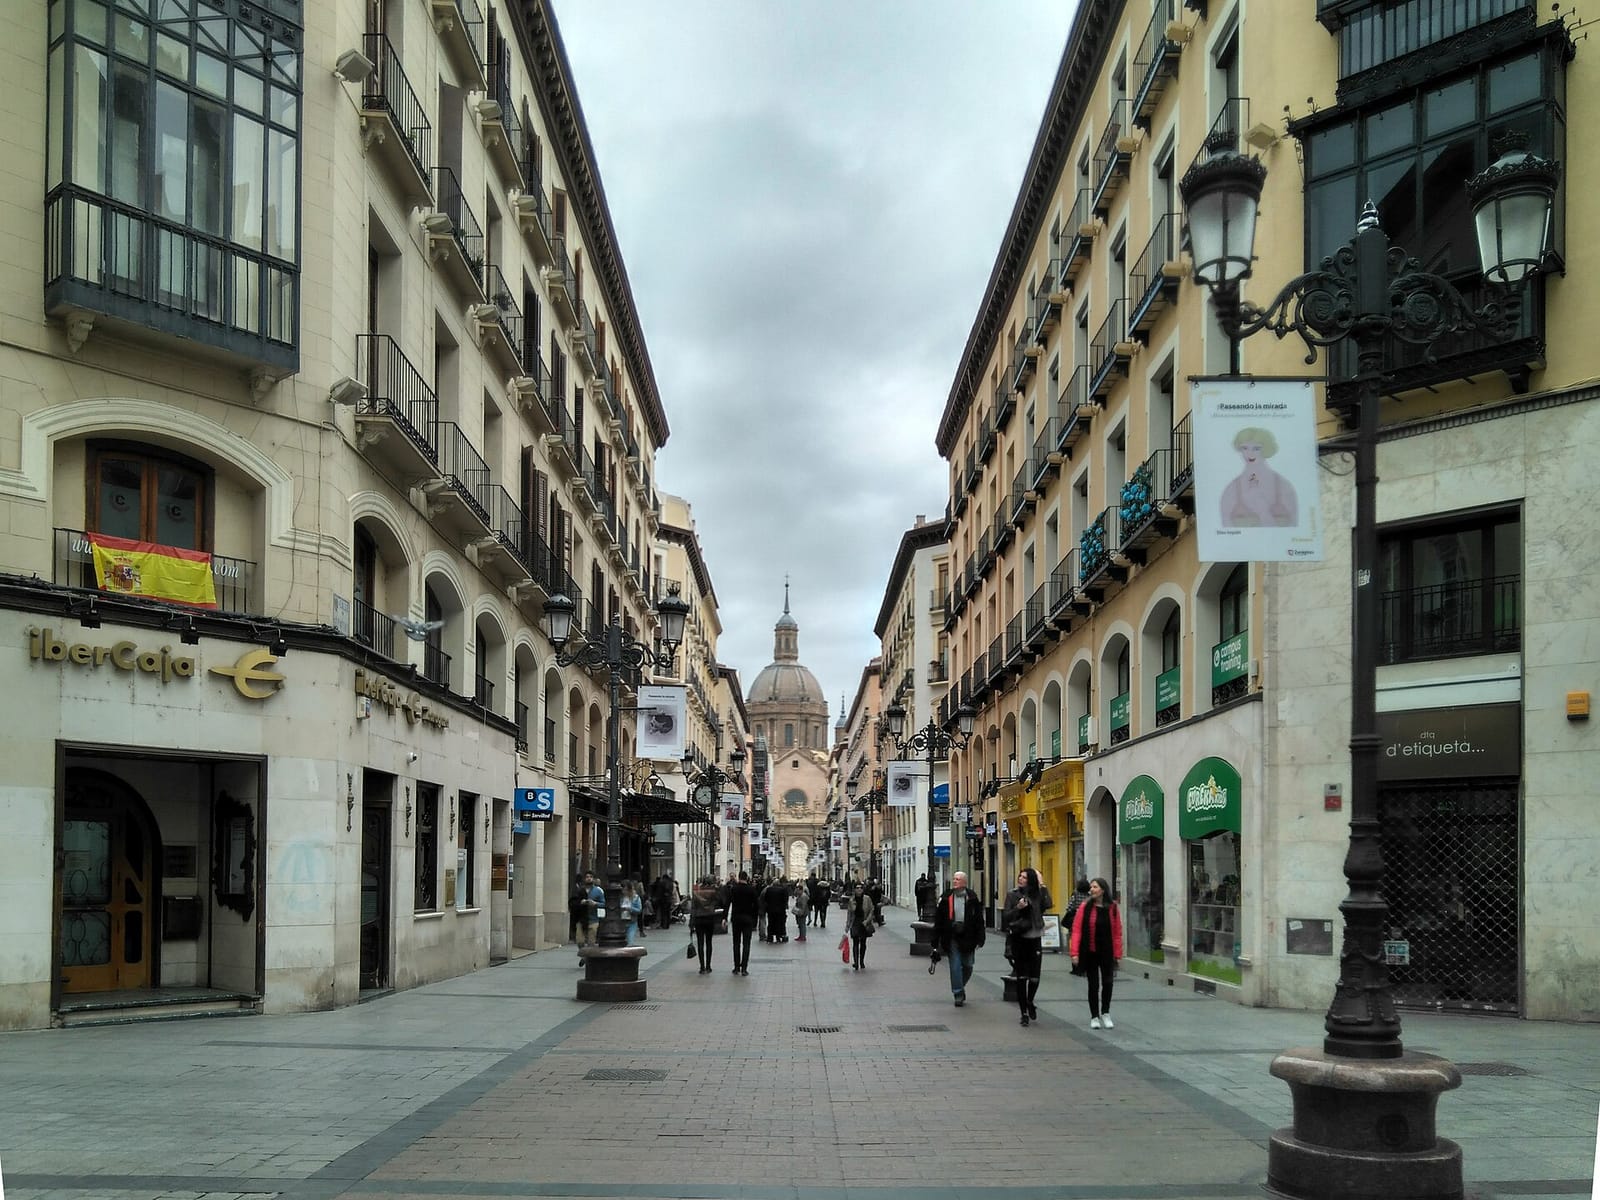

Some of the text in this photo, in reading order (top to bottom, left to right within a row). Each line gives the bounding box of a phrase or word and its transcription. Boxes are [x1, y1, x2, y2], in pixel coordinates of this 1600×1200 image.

[1221, 639, 1242, 659] campus
[1386, 740, 1485, 758] d'etiqueta...
[537, 791, 552, 810] S
